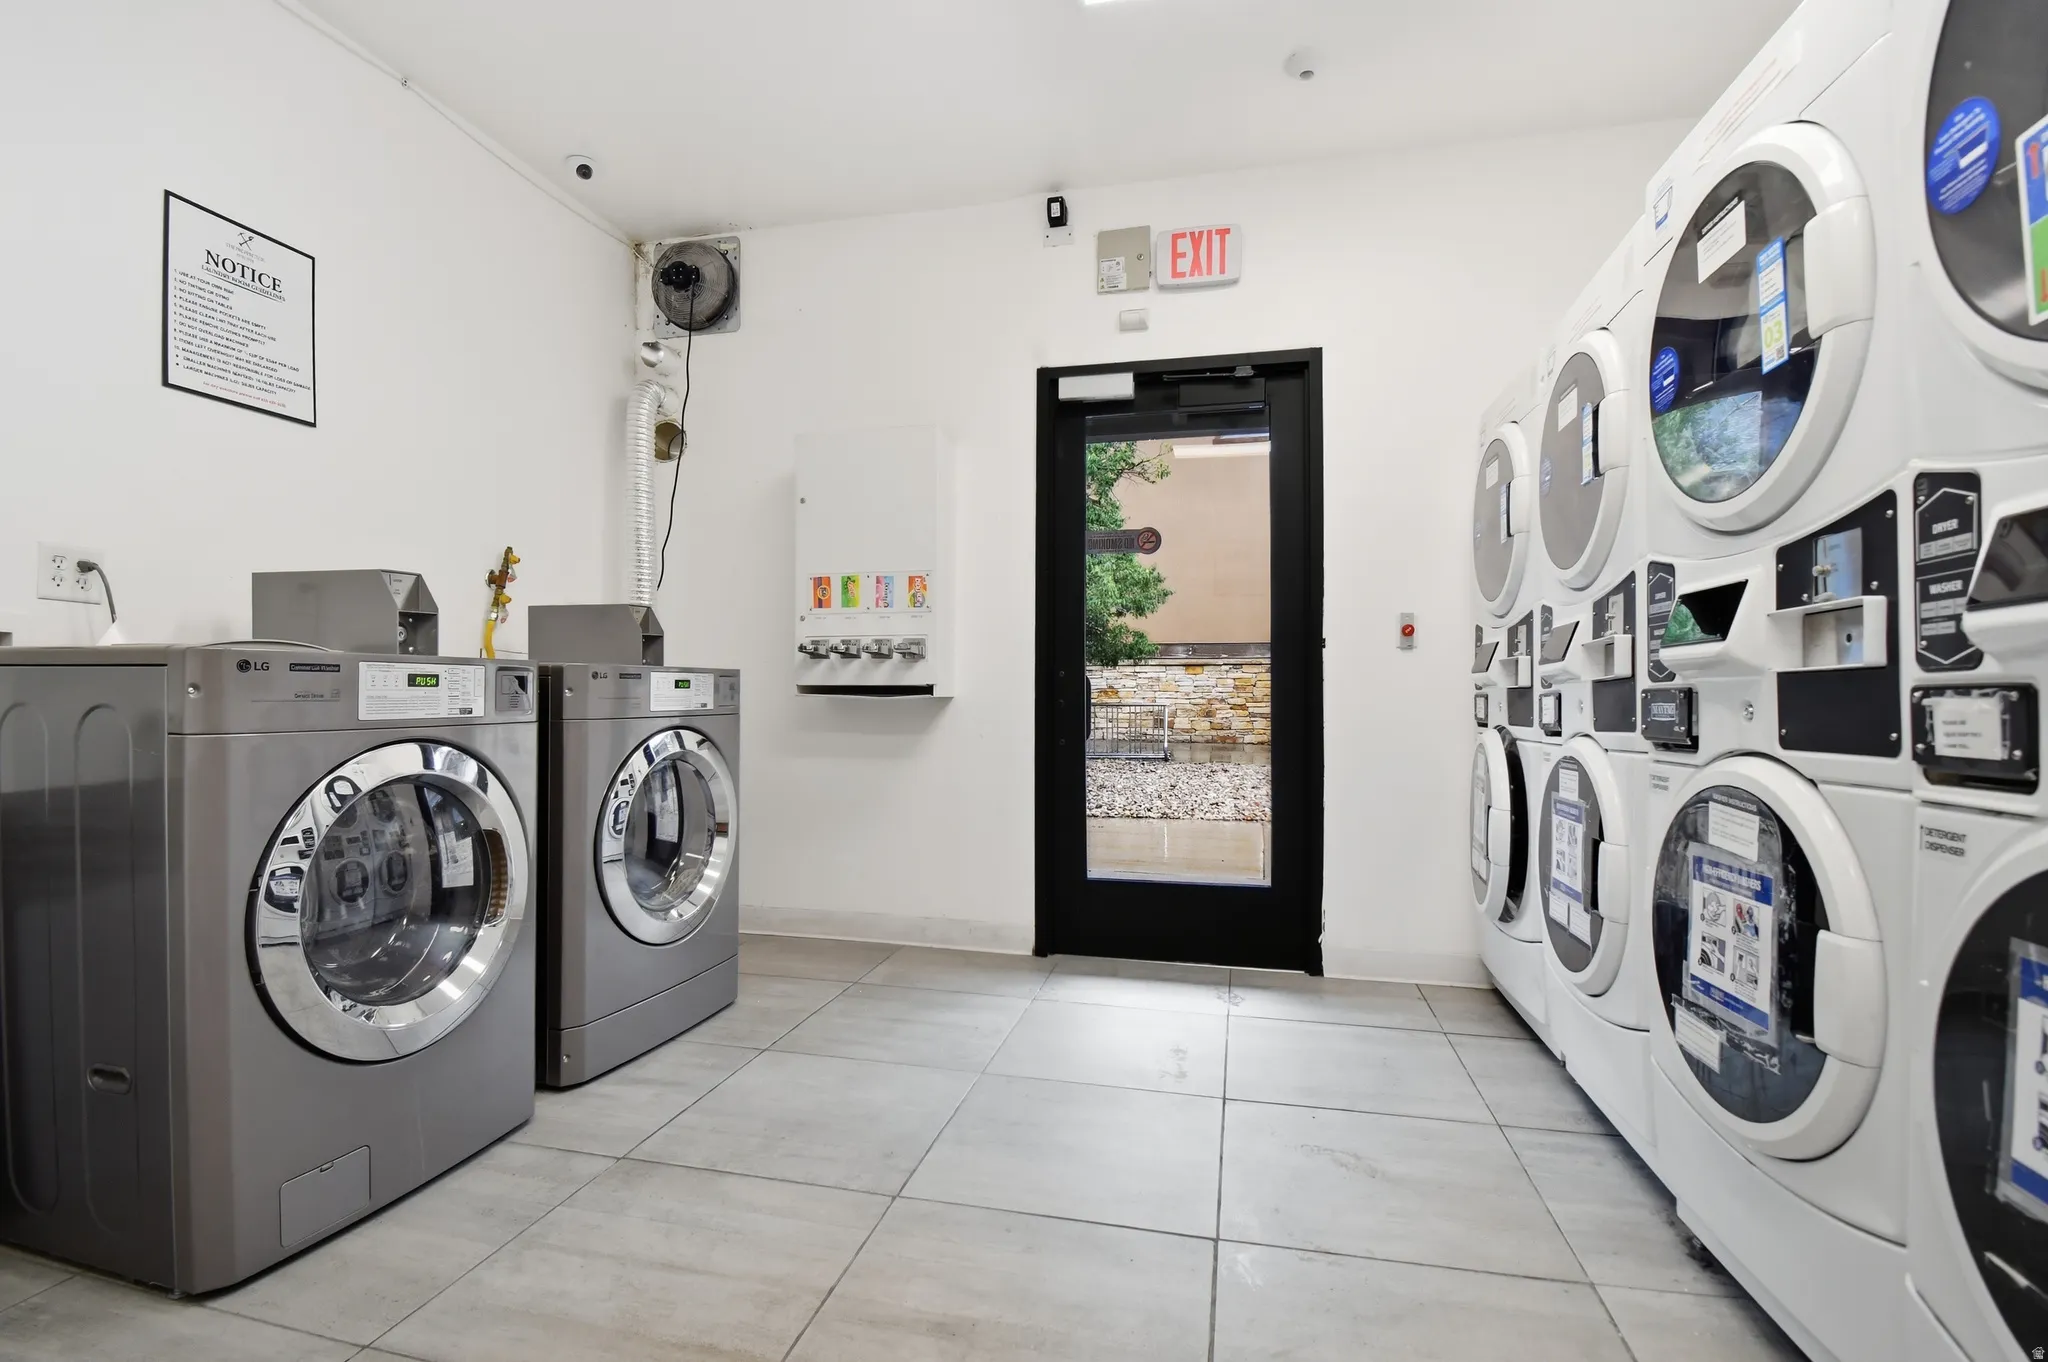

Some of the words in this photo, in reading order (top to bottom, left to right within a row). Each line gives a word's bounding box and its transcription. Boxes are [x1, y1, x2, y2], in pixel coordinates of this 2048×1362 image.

[1170, 228, 1230, 279] EXIT
[205, 248, 282, 294] NOTICE
[201, 264, 229, 280] LAUNDRY
[231, 276, 249, 288] ROOM
[251, 283, 285, 302] GUIDELINES
[1764, 319, 1784, 349] 03
[1931, 518, 1959, 535] DRYER
[1928, 579, 1963, 595] WASHER
[253, 661, 270, 672] LG
[415, 676, 438, 686] PUSH
[1924, 826, 1967, 844] DETERGENT
[1924, 841, 1965, 858] DISPENSER
